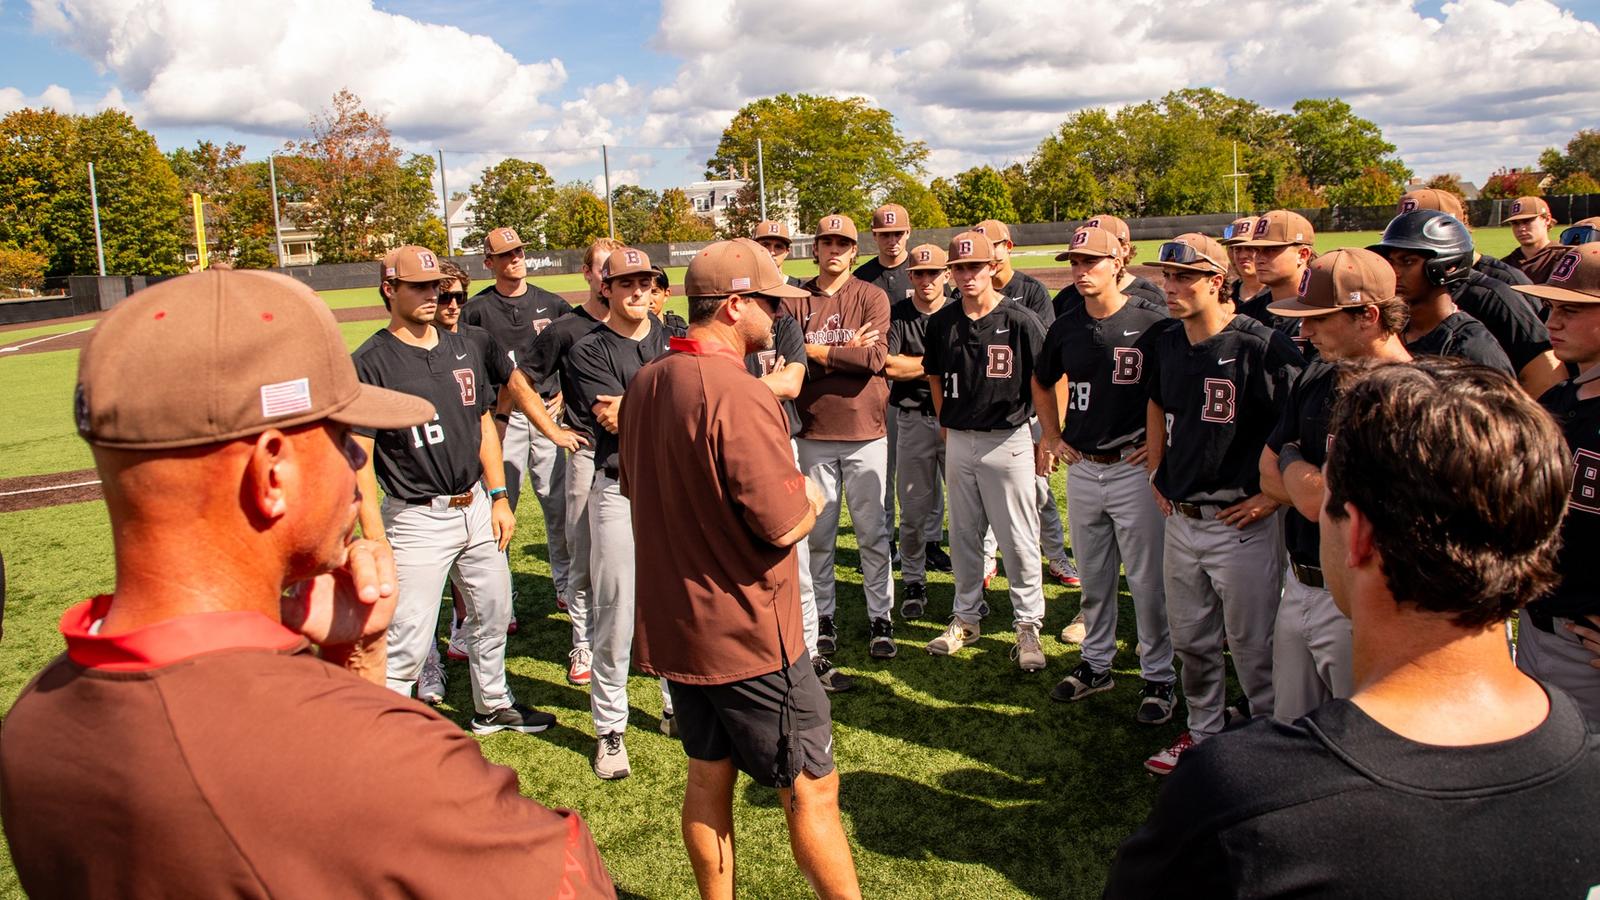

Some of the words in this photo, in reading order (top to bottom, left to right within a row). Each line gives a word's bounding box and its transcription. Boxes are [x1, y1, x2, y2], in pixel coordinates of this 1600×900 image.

[1511, 202, 1522, 214] B
[828, 217, 843, 232] B
[883, 211, 897, 225] B
[768, 221, 780, 235] B
[1238, 221, 1252, 235] B
[1256, 218, 1270, 237] B
[502, 230, 515, 243] B
[1072, 231, 1088, 247] B
[919, 249, 931, 262] B
[959, 240, 973, 257] B
[418, 252, 436, 271] B
[625, 251, 641, 267] B
[1550, 252, 1582, 282] B
[806, 329, 855, 344] BROWN
[986, 345, 1013, 378] B
[1112, 347, 1143, 384] B
[453, 368, 476, 406] B
[1201, 378, 1236, 423] B
[411, 412, 445, 449] 16
